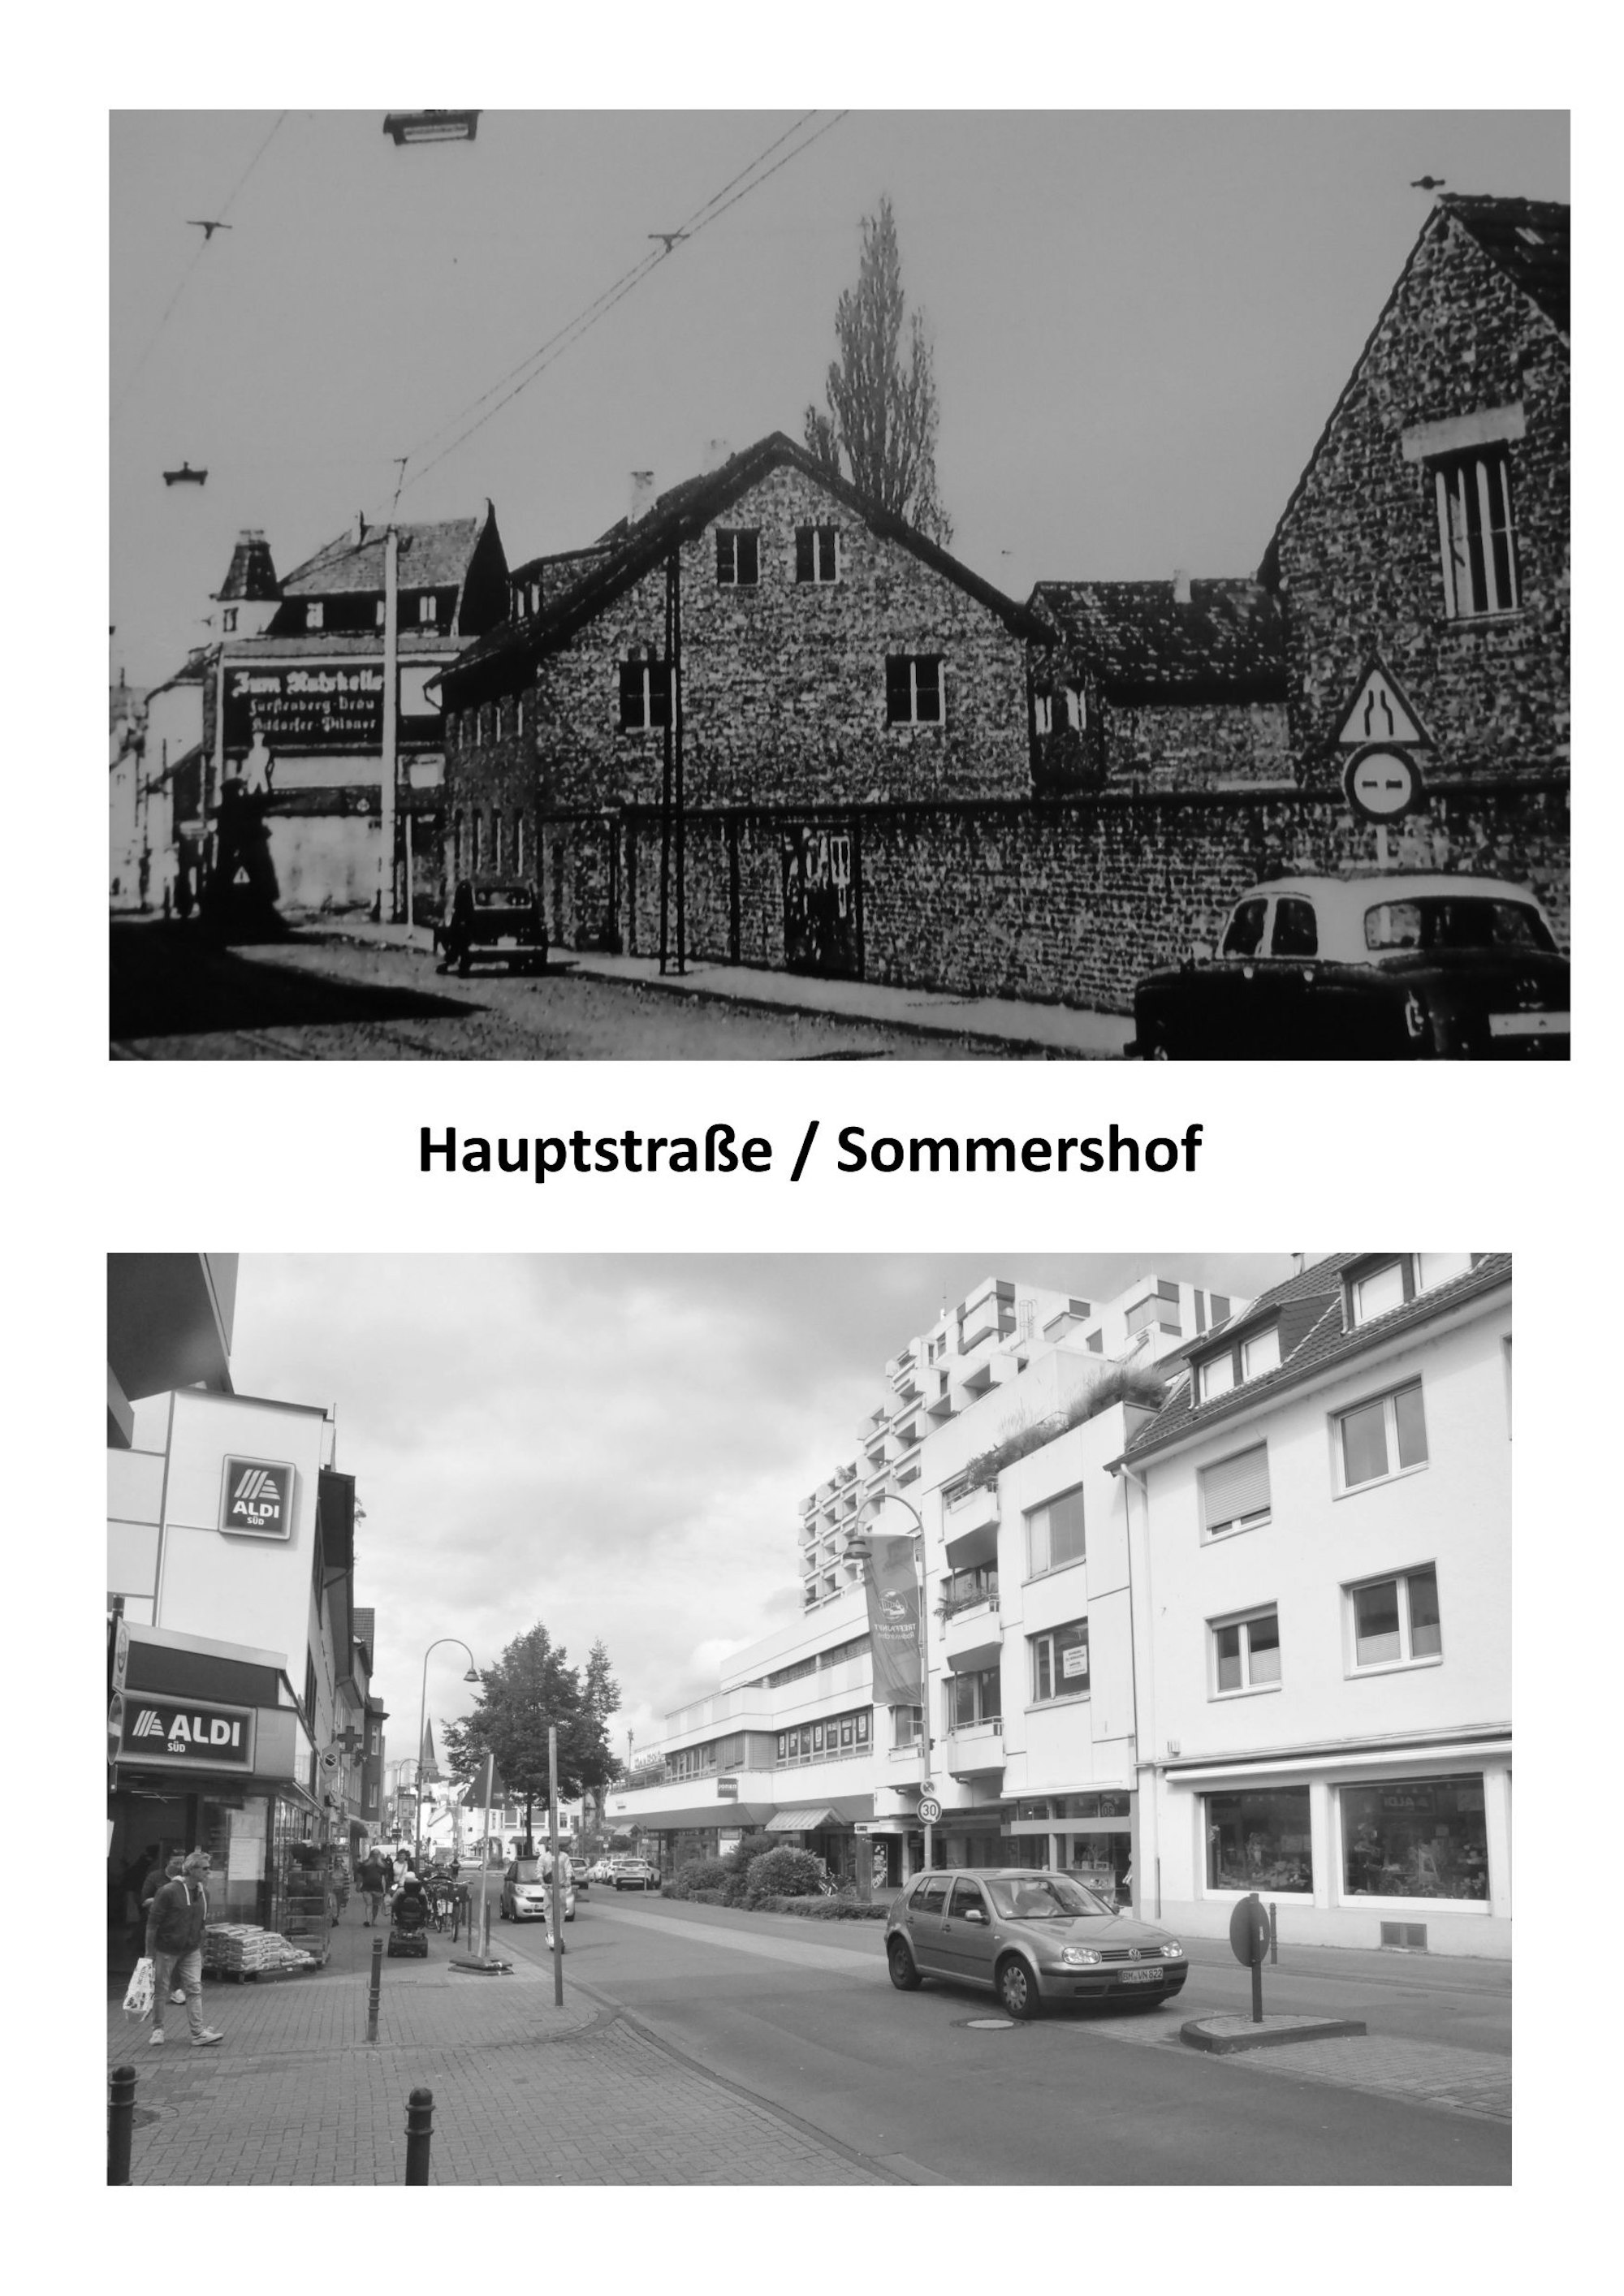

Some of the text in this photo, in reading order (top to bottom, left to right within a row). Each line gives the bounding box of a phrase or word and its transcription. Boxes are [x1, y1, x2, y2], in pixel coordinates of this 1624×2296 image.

[231, 671, 281, 697] Zum
[232, 1500, 279, 1518] ALDI
[247, 1516, 265, 1526] SÜD
[167, 1714, 241, 1747] ALDI
[166, 1740, 186, 1753] SÜD
[922, 1804, 937, 1816] 30
